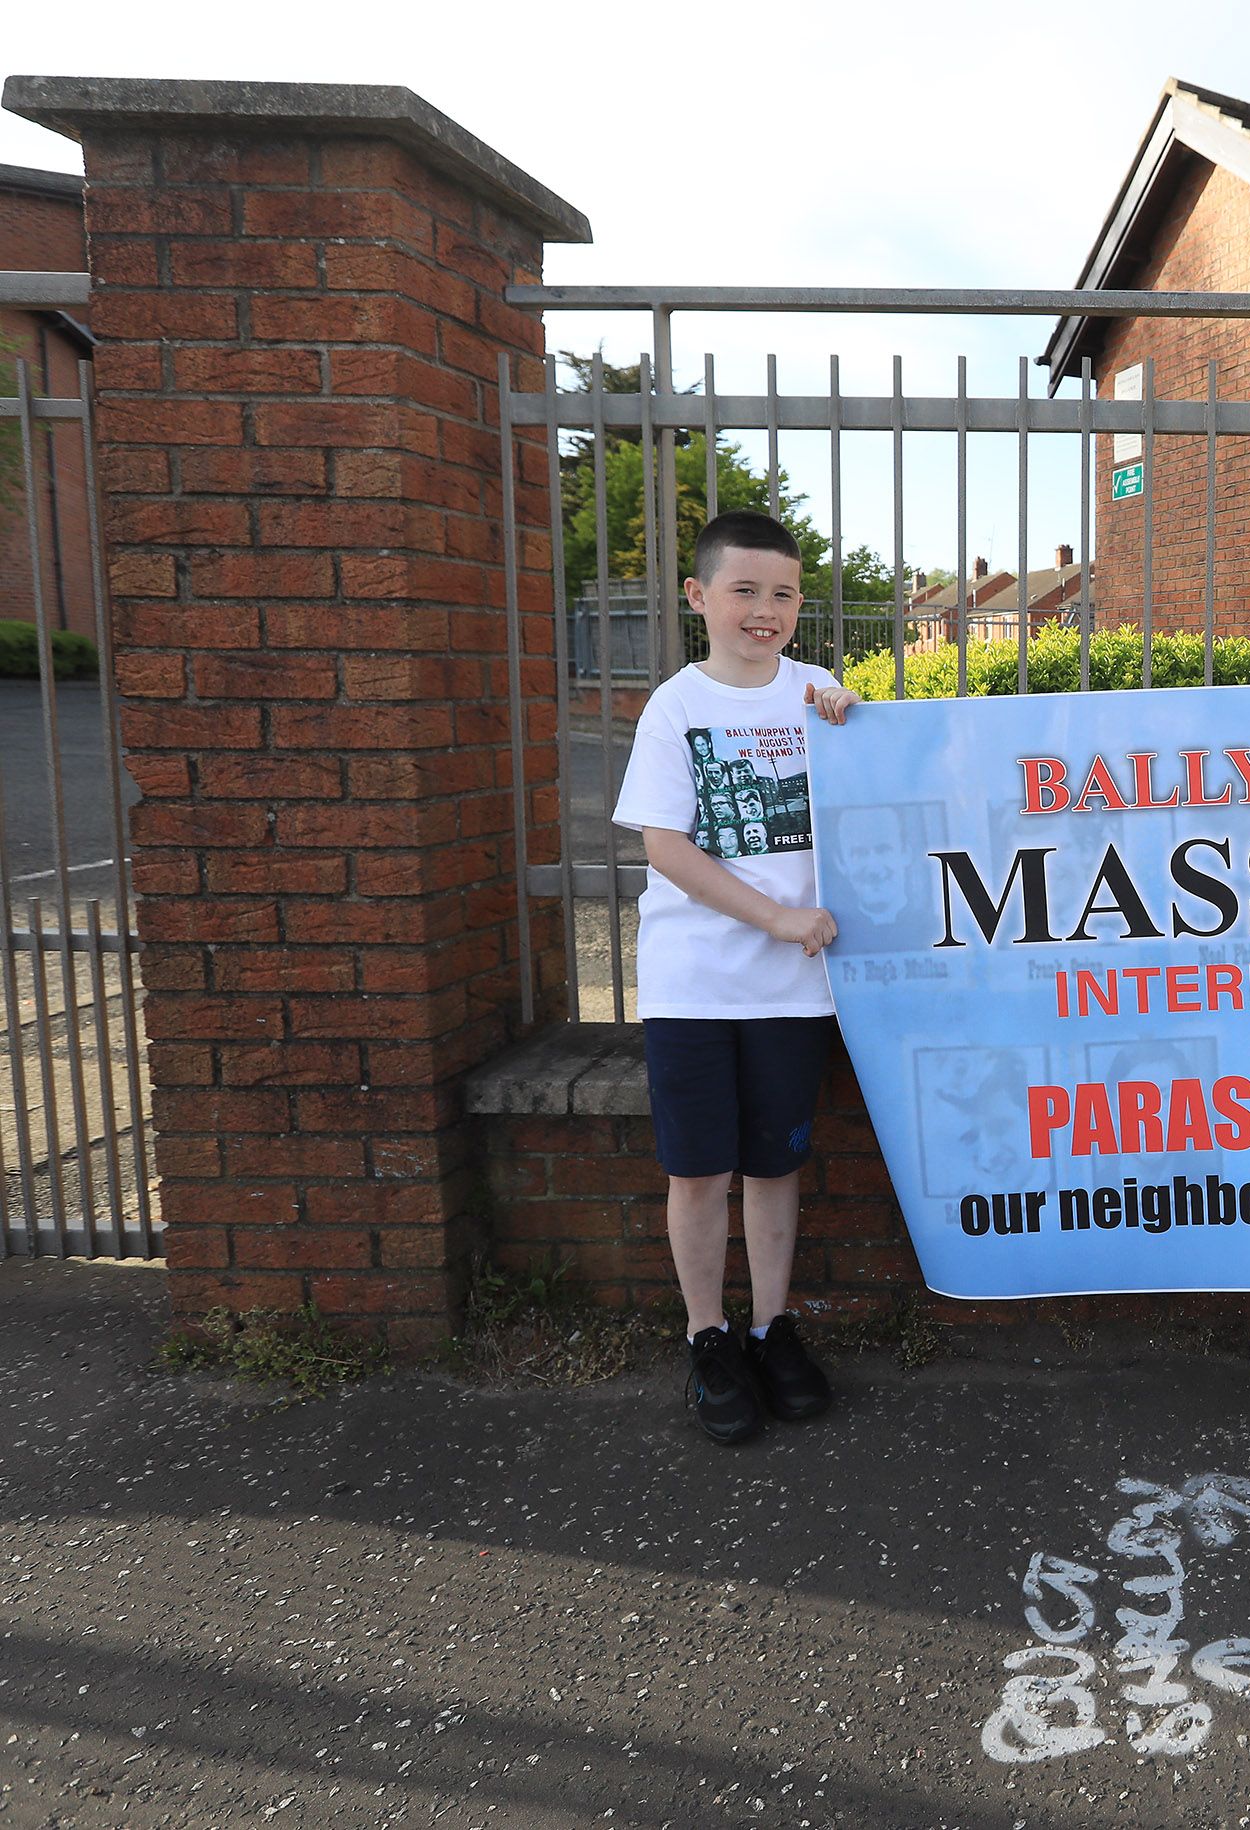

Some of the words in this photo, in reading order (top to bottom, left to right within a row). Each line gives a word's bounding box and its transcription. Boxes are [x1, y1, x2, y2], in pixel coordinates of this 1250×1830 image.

[759, 736, 793, 748] AUGUST
[738, 748, 754, 758] WE
[755, 747, 794, 758] DEMAND
[774, 834, 804, 846] FREE
[960, 1190, 1047, 1236] our
